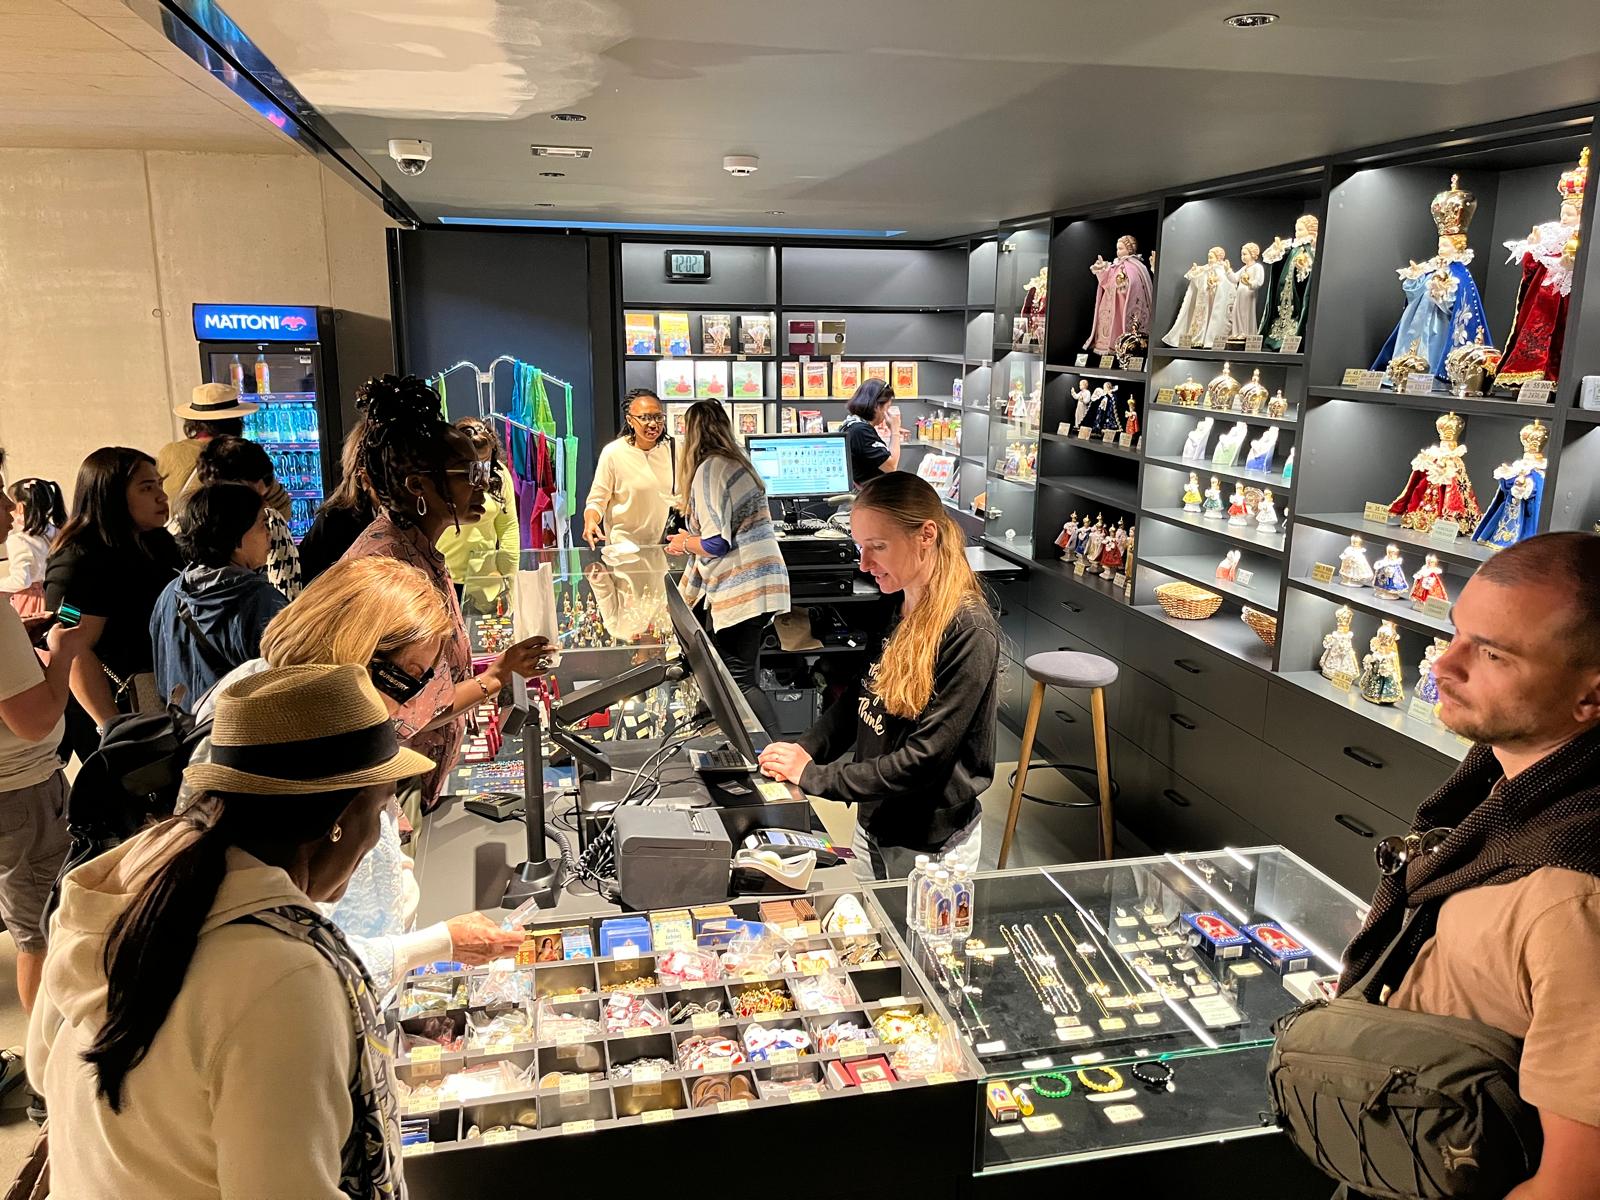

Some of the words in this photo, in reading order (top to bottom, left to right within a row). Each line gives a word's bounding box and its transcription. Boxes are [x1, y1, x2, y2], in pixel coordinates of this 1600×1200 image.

[205, 313, 279, 330] MATTONI
[378, 669, 409, 691] BURBERRY
[858, 696, 885, 736] Think
